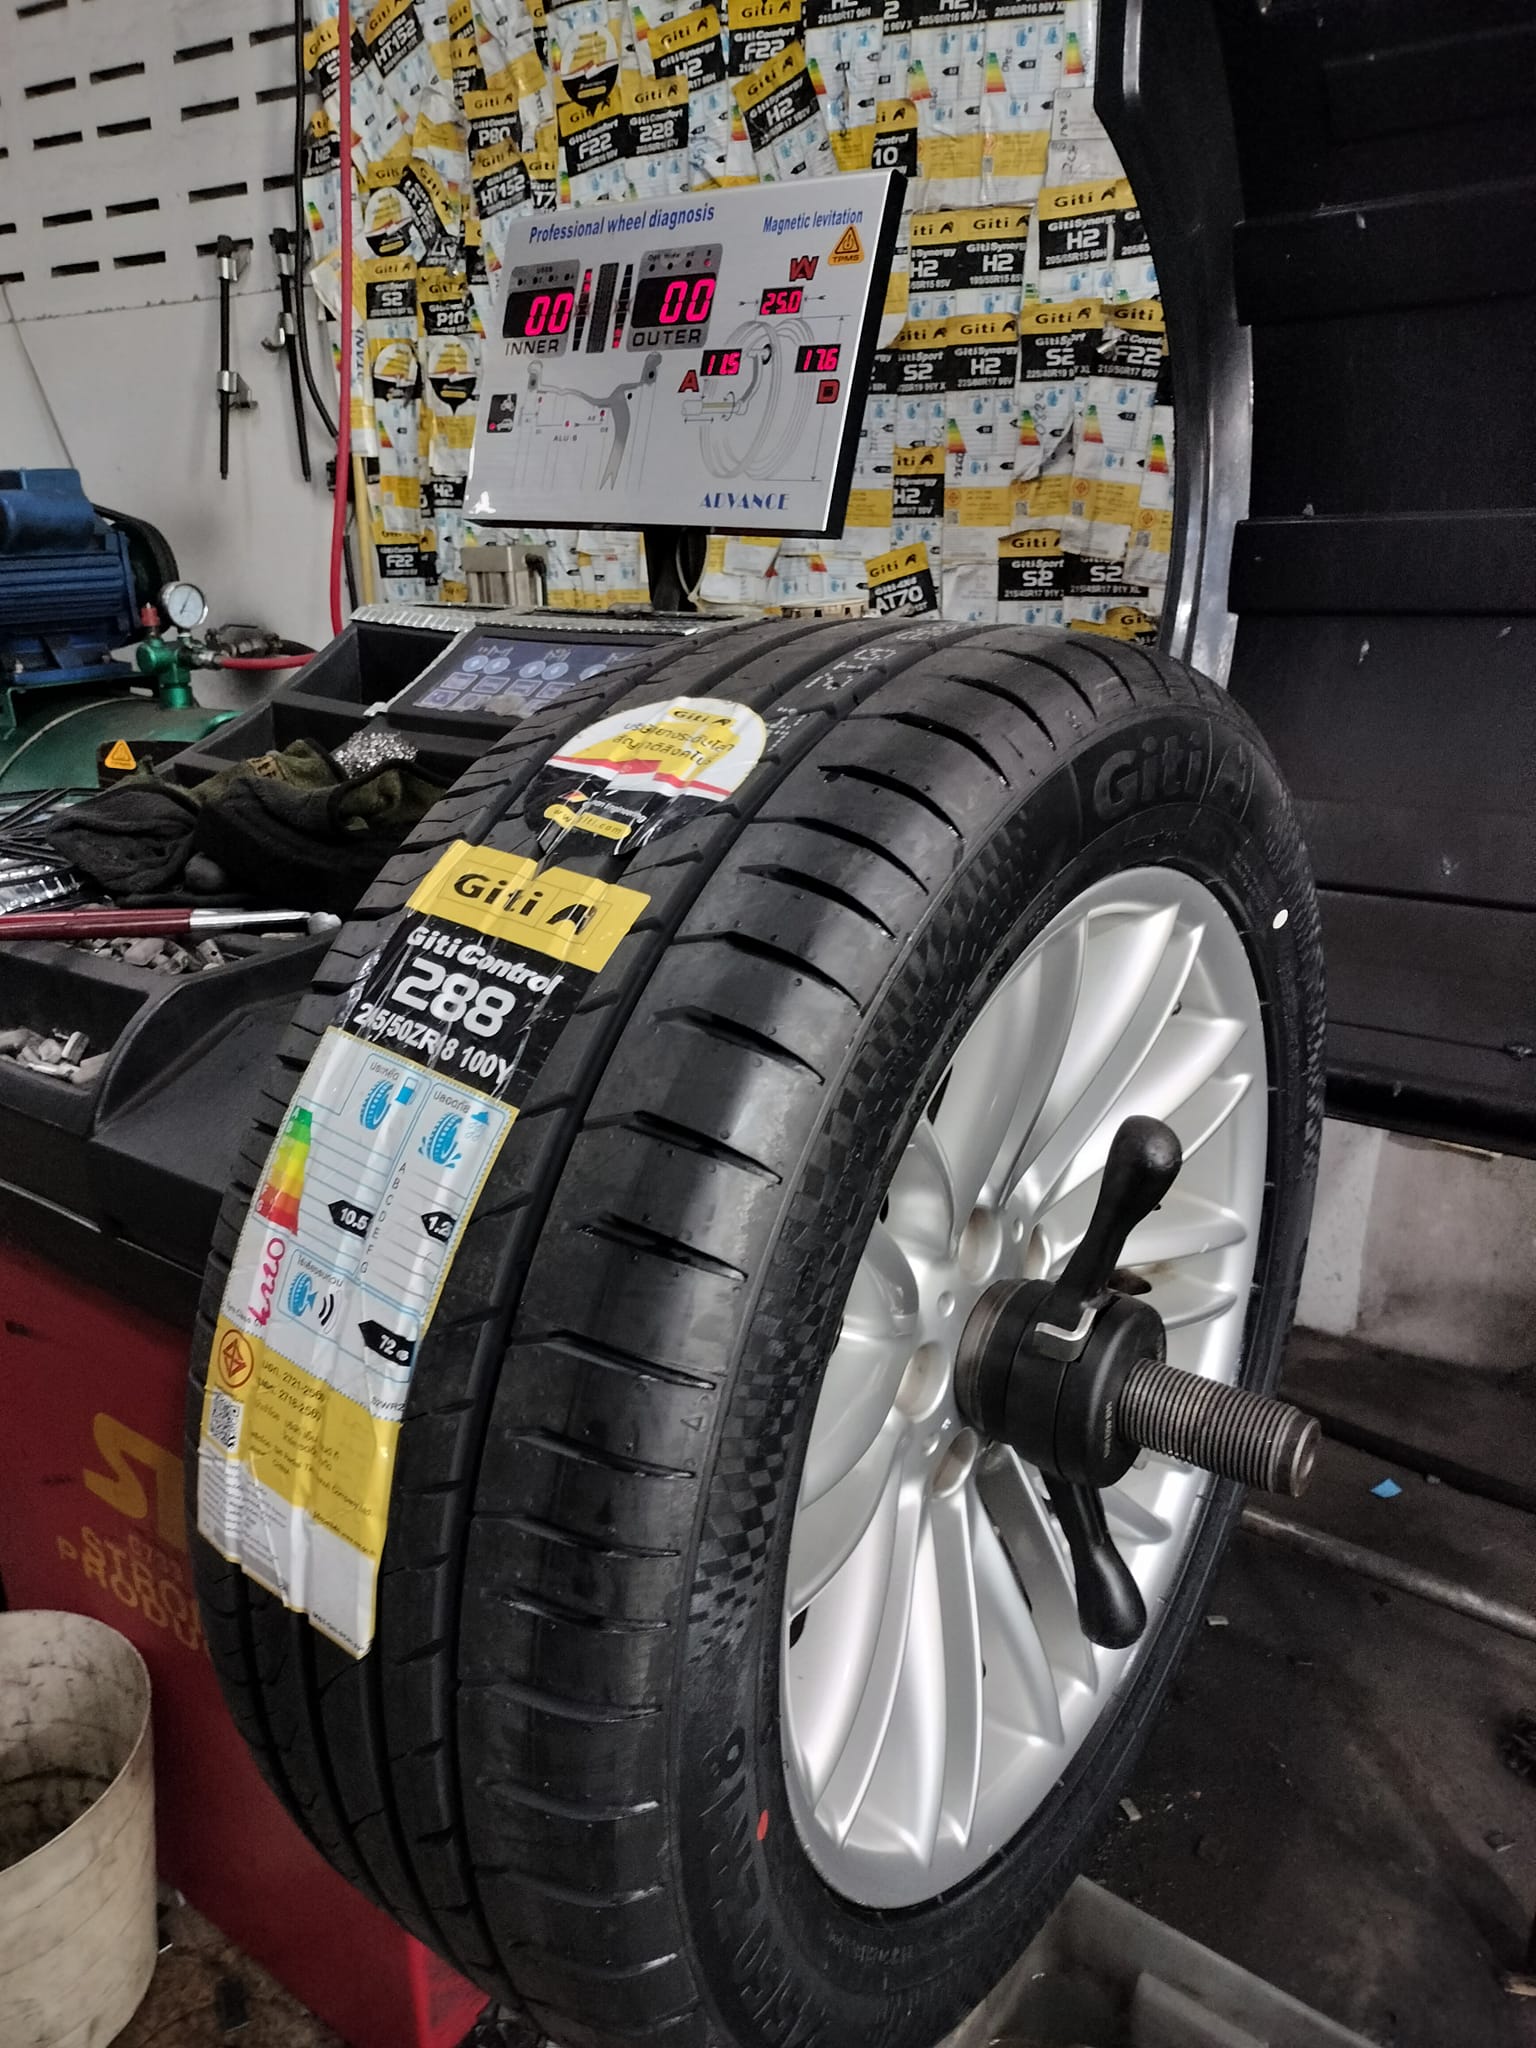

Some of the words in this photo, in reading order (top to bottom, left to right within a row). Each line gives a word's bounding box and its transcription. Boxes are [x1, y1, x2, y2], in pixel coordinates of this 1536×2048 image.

[369, 7, 391, 32] Giti
[741, 4, 774, 19] Giti
[373, 19, 418, 67] HT152
[660, 25, 690, 46] Giti
[744, 39, 786, 61] F22
[675, 57, 704, 78] H2
[747, 69, 777, 96] Giti
[474, 94, 500, 110] Giti
[634, 89, 662, 105] Giti
[765, 97, 796, 128] H2
[639, 119, 675, 144] 228
[578, 132, 613, 162] F22
[479, 173, 526, 207] HT152
[1054, 191, 1094, 208] Giti
[528, 217, 605, 244] Professional
[607, 211, 647, 233] wheel
[649, 203, 716, 231] diagnosis
[762, 214, 810, 236] Magnetic
[812, 207, 863, 228] levitation
[973, 215, 1009, 231] Giti
[1066, 228, 1101, 251] H2
[789, 255, 820, 282] W
[832, 254, 860, 263] TPMS
[982, 252, 1015, 274] H2
[658, 278, 717, 324] 00
[524, 292, 575, 336] 00
[1035, 311, 1072, 325] Giti
[1113, 307, 1154, 322] Giti
[632, 328, 702, 347] OUTER
[960, 322, 996, 335] Giti
[504, 339, 560, 356] INNER
[903, 363, 934, 382] S2
[970, 357, 1002, 376] H2
[678, 369, 699, 393] A
[816, 379, 840, 404] D
[701, 492, 790, 511] ADVANCE
[1011, 537, 1047, 549] Giti
[385, 554, 415, 569] F22
[869, 559, 899, 578] Giti
[1022, 569, 1054, 587] S2
[1089, 565, 1123, 583] S2
[875, 584, 924, 613] AT70
[672, 709, 710, 725] Giti
[453, 873, 544, 917] Giti
[406, 926, 565, 996] GitiControl
[391, 957, 516, 1038] 288
[352, 1002, 460, 1062] 25/50ZR8
[460, 1045, 516, 1085] 100Y
[338, 1206, 370, 1232] 10.5
[427, 1215, 451, 1238] 1.2
[379, 1333, 397, 1357] 72
